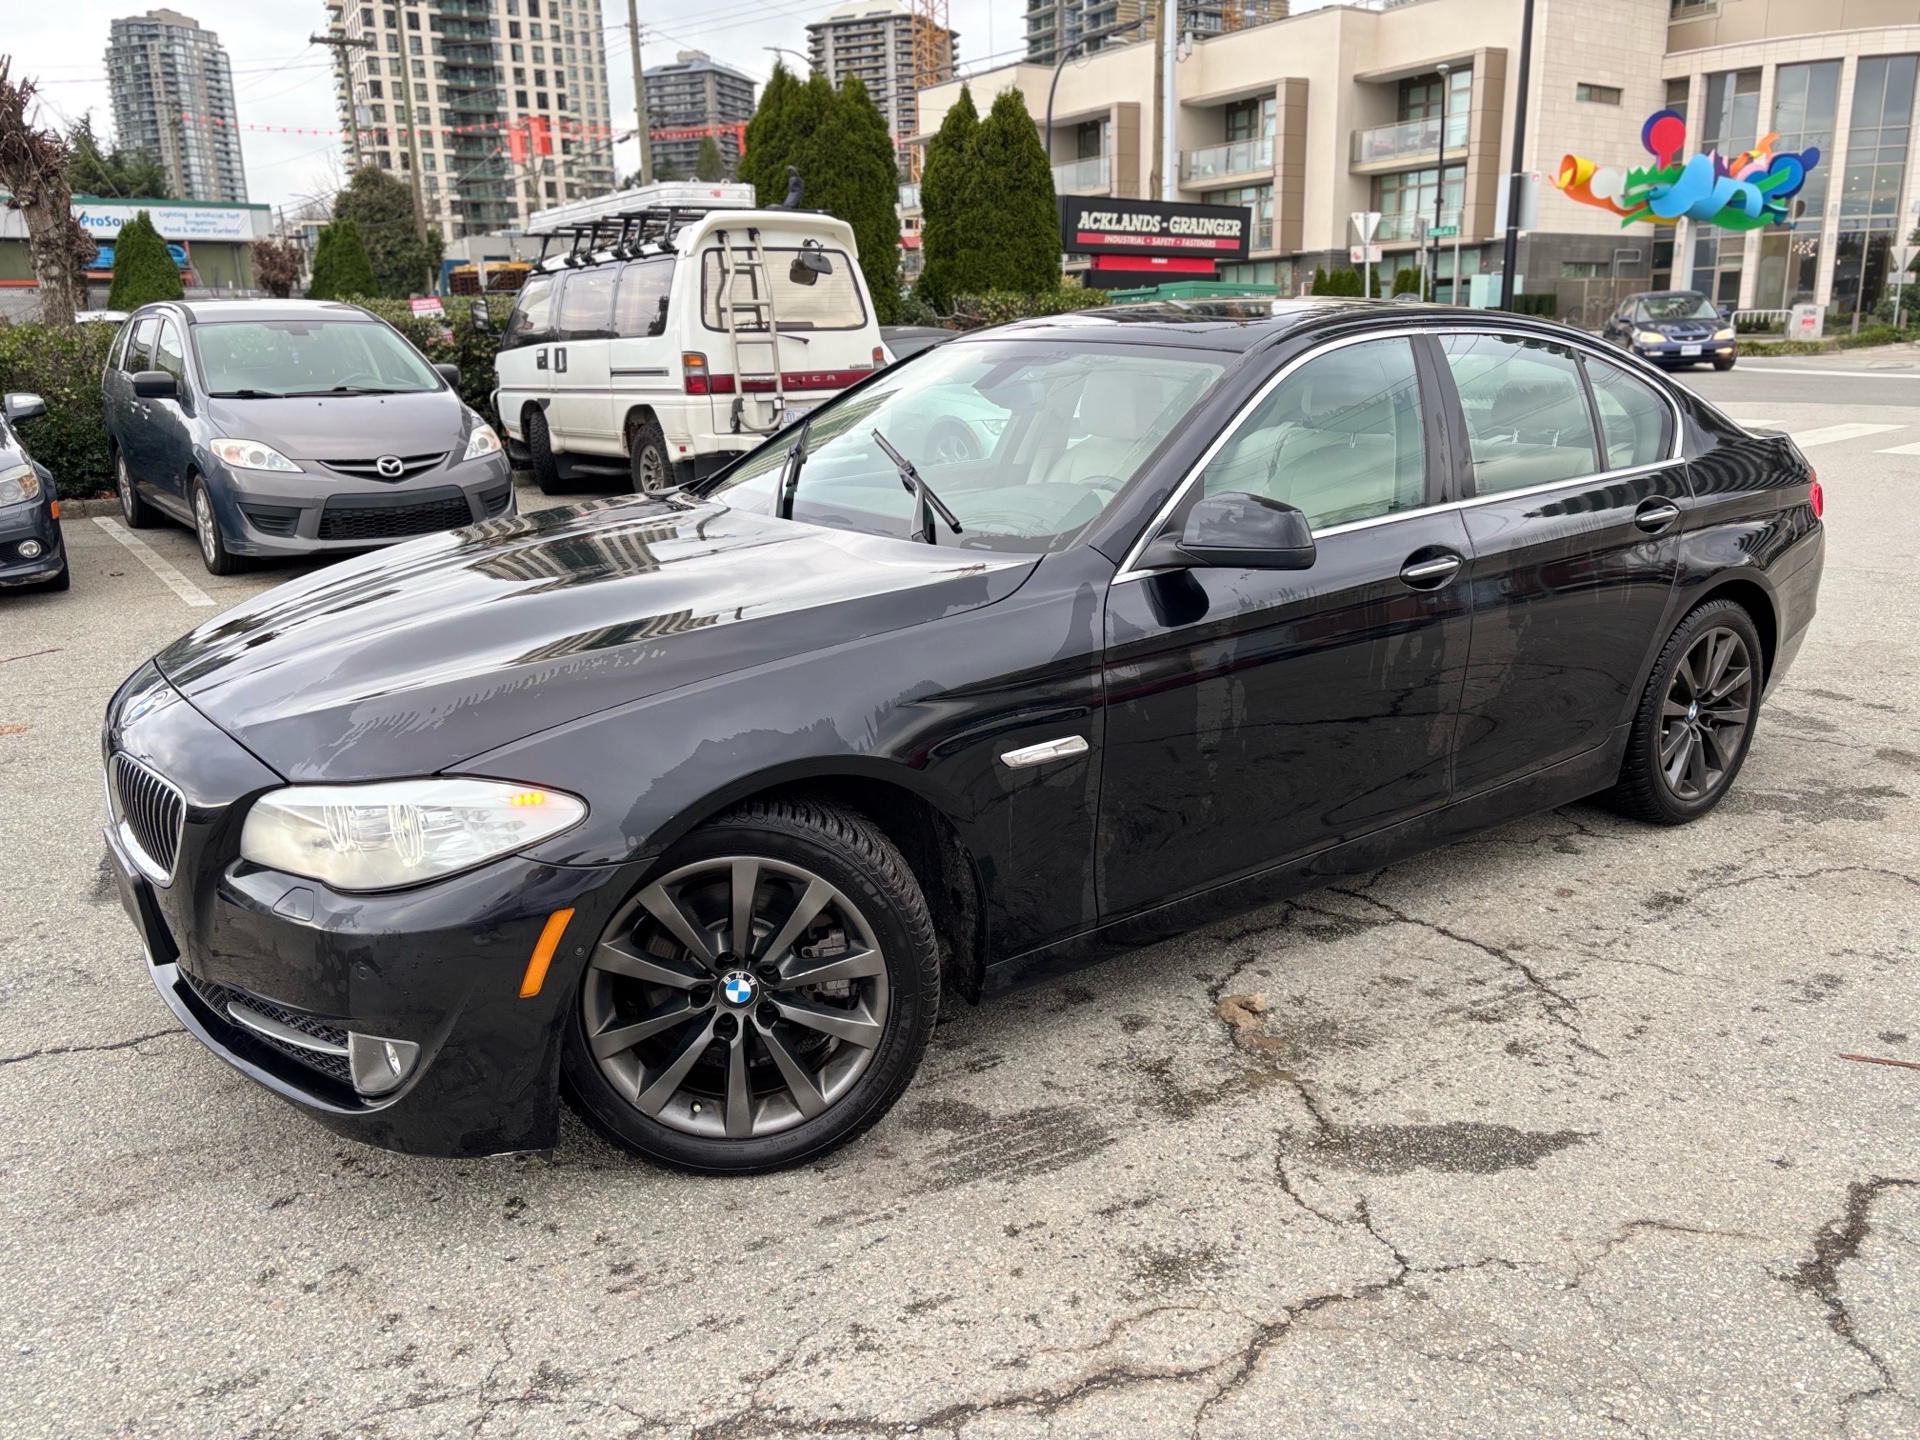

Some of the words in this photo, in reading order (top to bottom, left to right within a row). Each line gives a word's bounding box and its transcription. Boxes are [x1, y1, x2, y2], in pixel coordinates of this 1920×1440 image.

[1078, 211, 1241, 236] ACKLANDS-GRAINGER
[1103, 234, 1146, 246] INDUSTRIAL
[1151, 236, 1177, 247] SAFETY
[1181, 238, 1217, 249] FASTENERS
